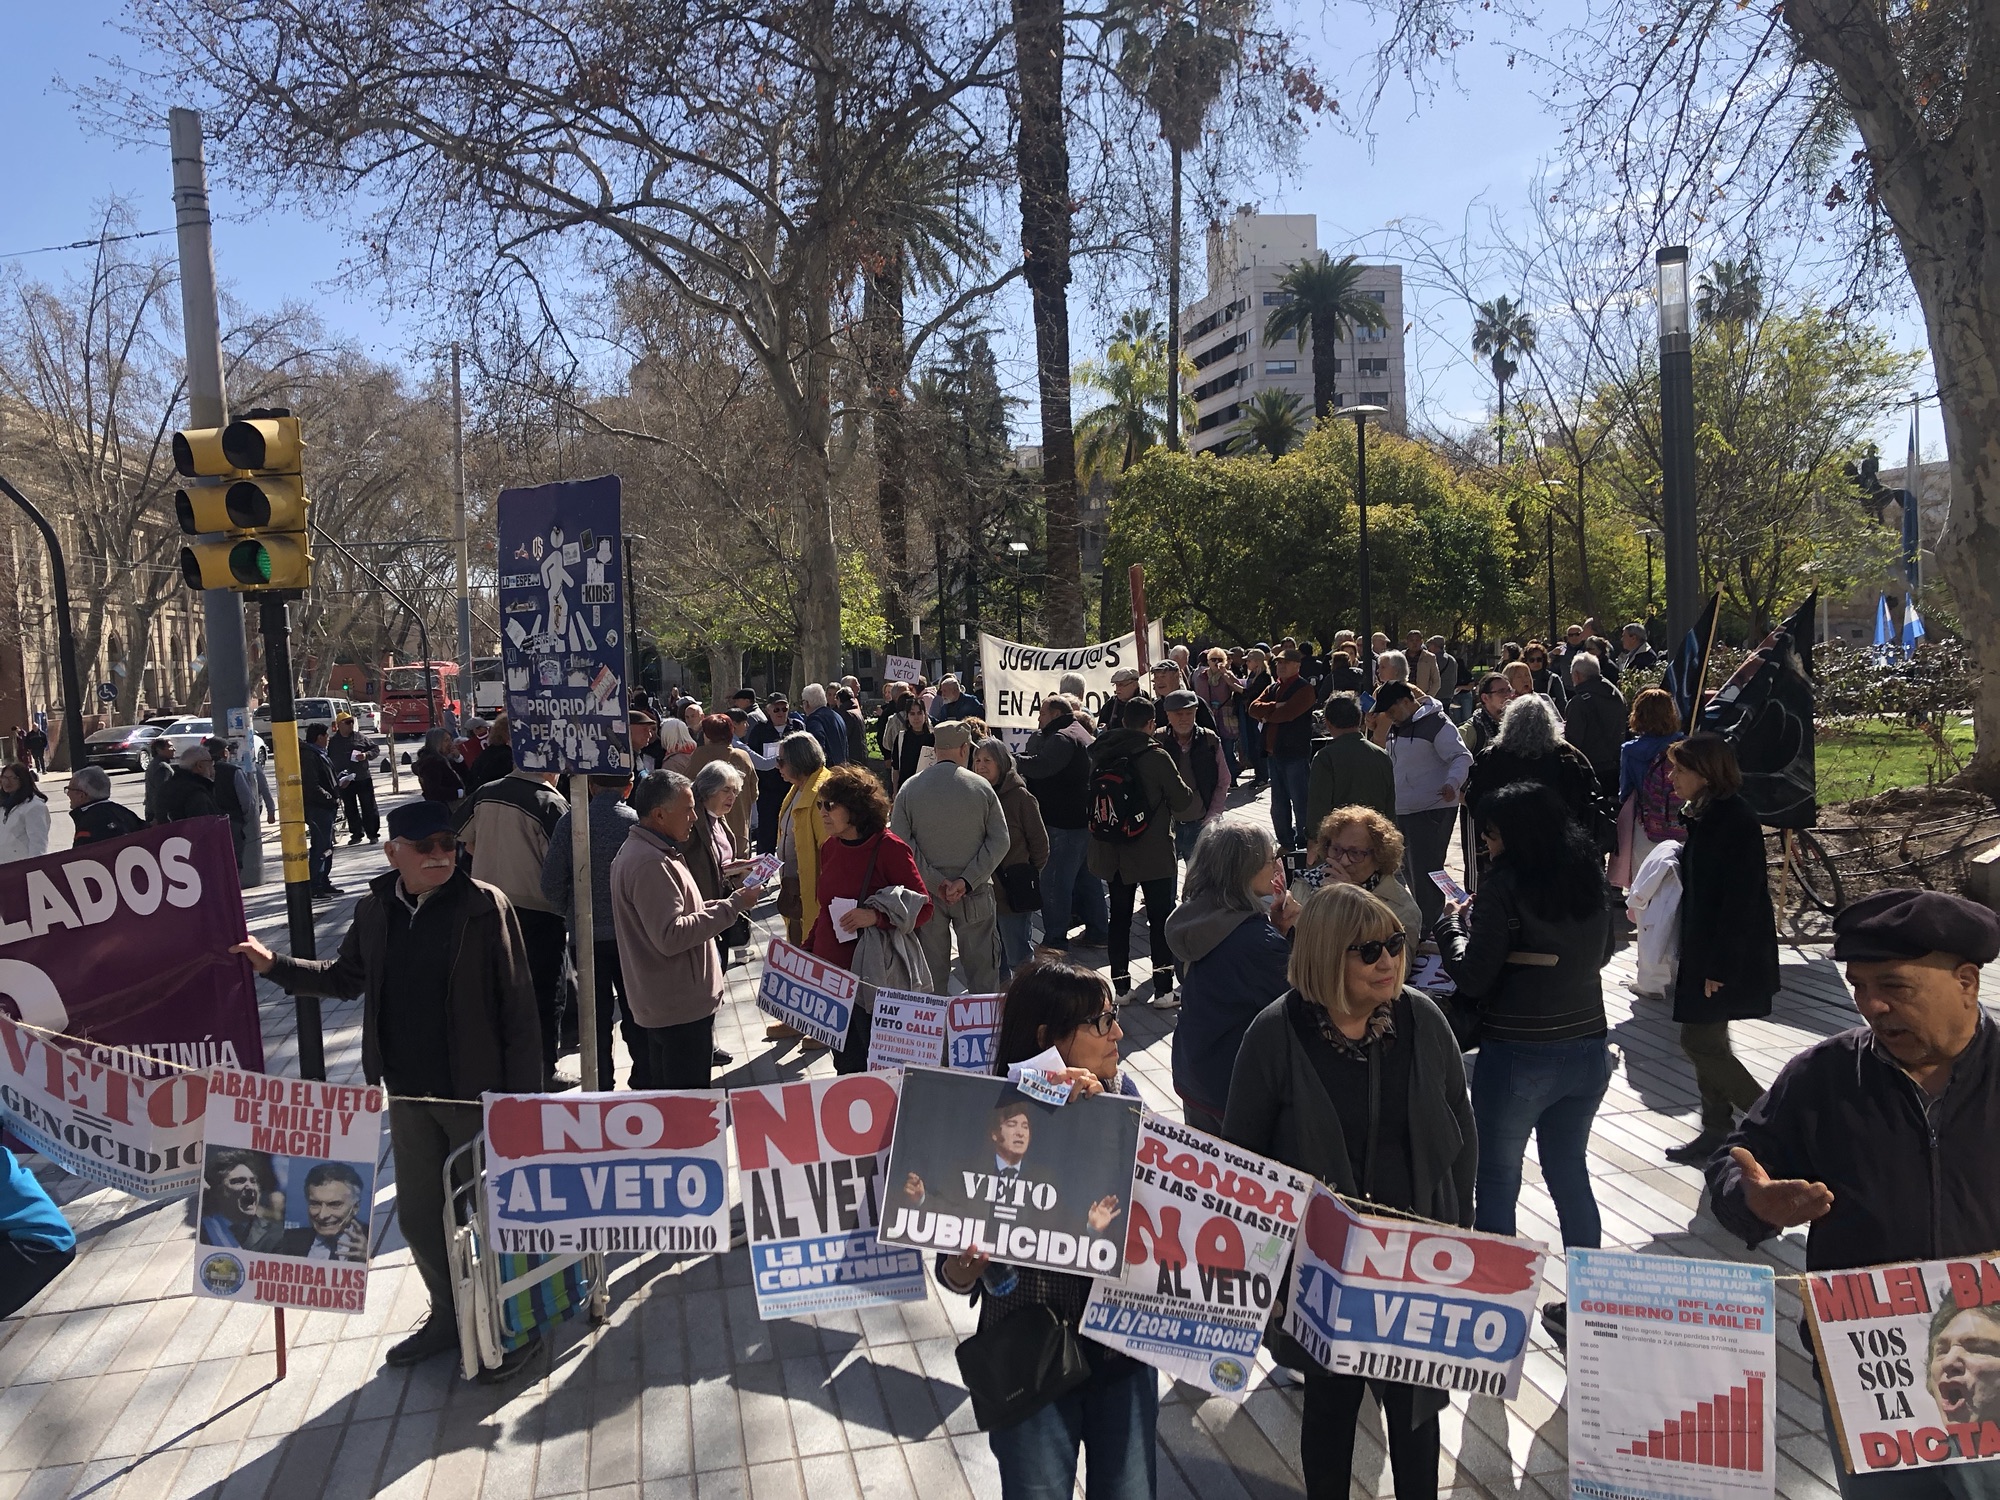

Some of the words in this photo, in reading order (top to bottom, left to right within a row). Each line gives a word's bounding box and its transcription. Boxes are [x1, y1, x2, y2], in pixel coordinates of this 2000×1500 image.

[585, 585, 610, 602] KIDS
[890, 658, 902, 667] NO
[904, 660, 916, 670] AL
[999, 641, 1120, 671] JUBILAD@S
[893, 669, 914, 679] VETO
[998, 690, 1023, 716] EN
[772, 943, 850, 999] MILEI
[767, 973, 838, 1028] BASURA
[880, 1004, 900, 1015] HAY
[914, 1009, 937, 1022] HAY
[771, 1004, 784, 1020] SOS
[785, 1011, 795, 1027] LA
[797, 1019, 841, 1049] DICTADURA
[875, 1017, 902, 1030] VETO
[906, 1022, 943, 1037] CALLE
[871, 1042, 914, 1056] SEPTIEMBRE
[0, 1016, 208, 1128] VETO
[209, 1070, 284, 1104] ABAJO
[290, 1082, 314, 1107] EL
[320, 1086, 383, 1114] VETO
[1031, 1082, 1067, 1099] AJUSTE
[234, 1098, 262, 1124] DE
[268, 1103, 332, 1135] MILEI
[338, 1111, 355, 1136] Y
[541, 1102, 664, 1151] NO
[731, 1076, 898, 1171] NO
[251, 1127, 331, 1159] MACRI
[1144, 1120, 1220, 1158] Jubilado
[1268, 1169, 1279, 1182] a
[1287, 1175, 1306, 1192] la
[507, 1168, 567, 1212] AL
[580, 1165, 707, 1210] VETO
[962, 1170, 1058, 1211] VETO
[1137, 1136, 1299, 1223] RONDA
[751, 1168, 801, 1242] AL
[804, 1155, 890, 1235] VET
[1135, 1164, 1157, 1185] DE
[1159, 1175, 1198, 1203] LAS
[1201, 1193, 1296, 1242] SILLAS!!!
[498, 1227, 555, 1253] VETO
[576, 1225, 718, 1252] JUBILICIDIO
[886, 1207, 1118, 1273] JUBILICIDIO
[1125, 1200, 1246, 1271] NO
[1341, 1227, 1475, 1285] NO
[249, 1260, 327, 1287] ¡ARRIBA
[331, 1267, 366, 1290] LXS
[1157, 1259, 1192, 1300] AL
[1197, 1263, 1272, 1308] VETO
[1706, 1278, 1720, 1288] UN
[1723, 1280, 1761, 1291] AJUSTE
[254, 1281, 365, 1311] JUBILADXS!
[1103, 1287, 1112, 1295] TE
[1114, 1289, 1165, 1305] ESPERAMOS
[1166, 1298, 1177, 1307] EN
[1179, 1301, 1205, 1312] PLAZA
[1207, 1305, 1225, 1315] SAN
[1125, 1300, 1135, 1309] TU
[1304, 1269, 1352, 1333] AL
[1373, 1293, 1507, 1353] VETO
[1661, 1297, 1674, 1306] LA
[1677, 1299, 1764, 1315] INFLACION
[1810, 1266, 1932, 1323] MILEI
[1581, 1300, 1673, 1321] GOBIERNO
[1679, 1310, 1703, 1324] DE
[1708, 1313, 1761, 1331] MILEI
[1293, 1311, 1331, 1366] VETO
[1352, 1351, 1507, 1397] JUBILICIDIO
[1847, 1327, 1907, 1359] VOS
[1857, 1358, 1915, 1391] SOS
[1874, 1390, 1915, 1421] LA
[1860, 1420, 2000, 1469] DICTA
